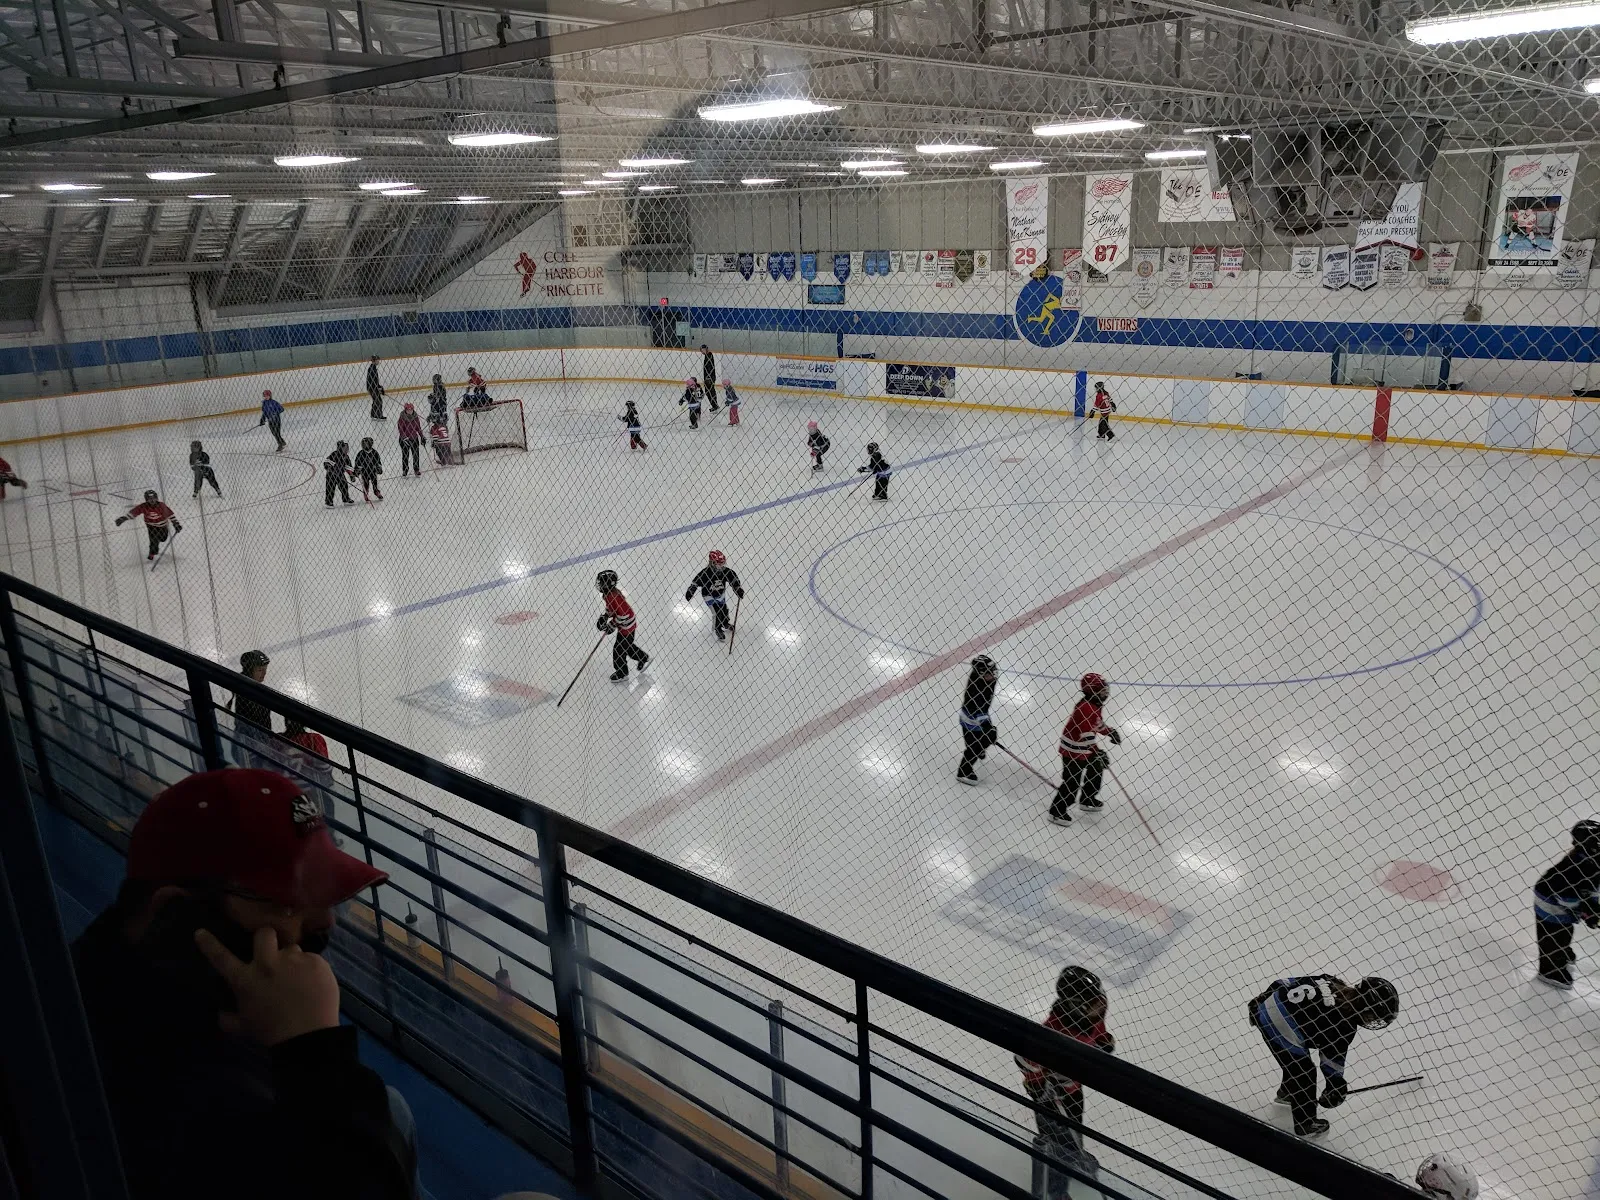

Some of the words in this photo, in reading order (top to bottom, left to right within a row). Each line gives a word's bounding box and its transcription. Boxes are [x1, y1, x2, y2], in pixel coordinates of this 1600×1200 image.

[1396, 204, 1409, 213] YOU
[1011, 215, 1035, 227] Nathan
[1388, 215, 1416, 225] COACHES
[1358, 228, 1373, 236] PAST
[1375, 227, 1388, 236] AND
[1390, 227, 1417, 236] PRESENT
[1015, 247, 1036, 265] 29
[1095, 244, 1118, 262] 87
[545, 266, 604, 280] HARBOUR
[546, 283, 604, 297] RINGETTE
[1098, 318, 1137, 331] VISITORS
[814, 363, 834, 374] HGS
